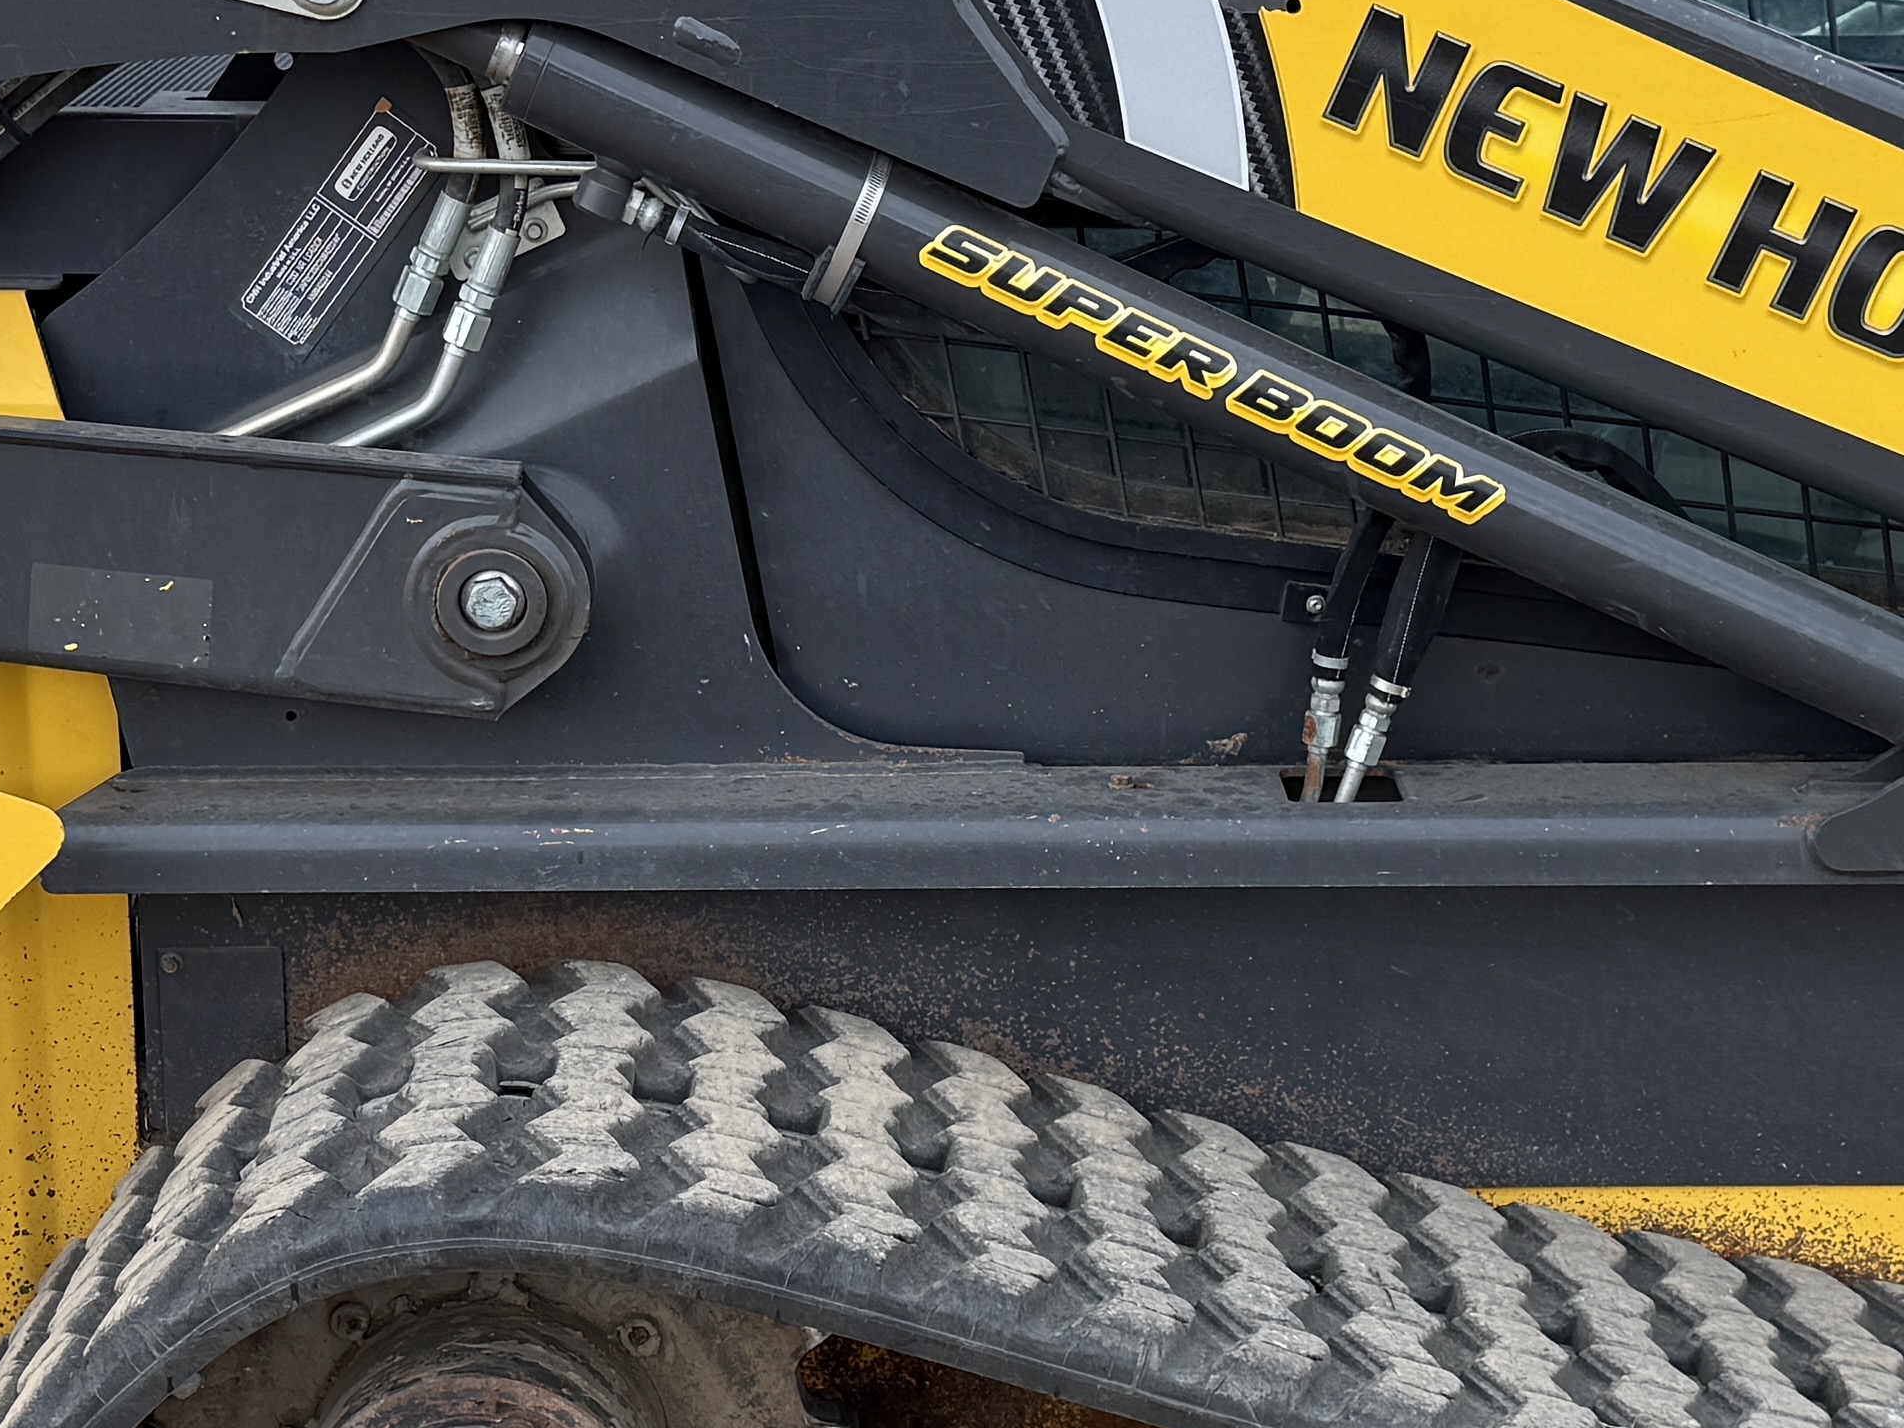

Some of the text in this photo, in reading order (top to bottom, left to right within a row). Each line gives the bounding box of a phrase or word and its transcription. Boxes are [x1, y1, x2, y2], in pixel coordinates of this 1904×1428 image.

[1320, 5, 1716, 257] NEW
[920, 225, 1506, 525] SUPER BOOM
